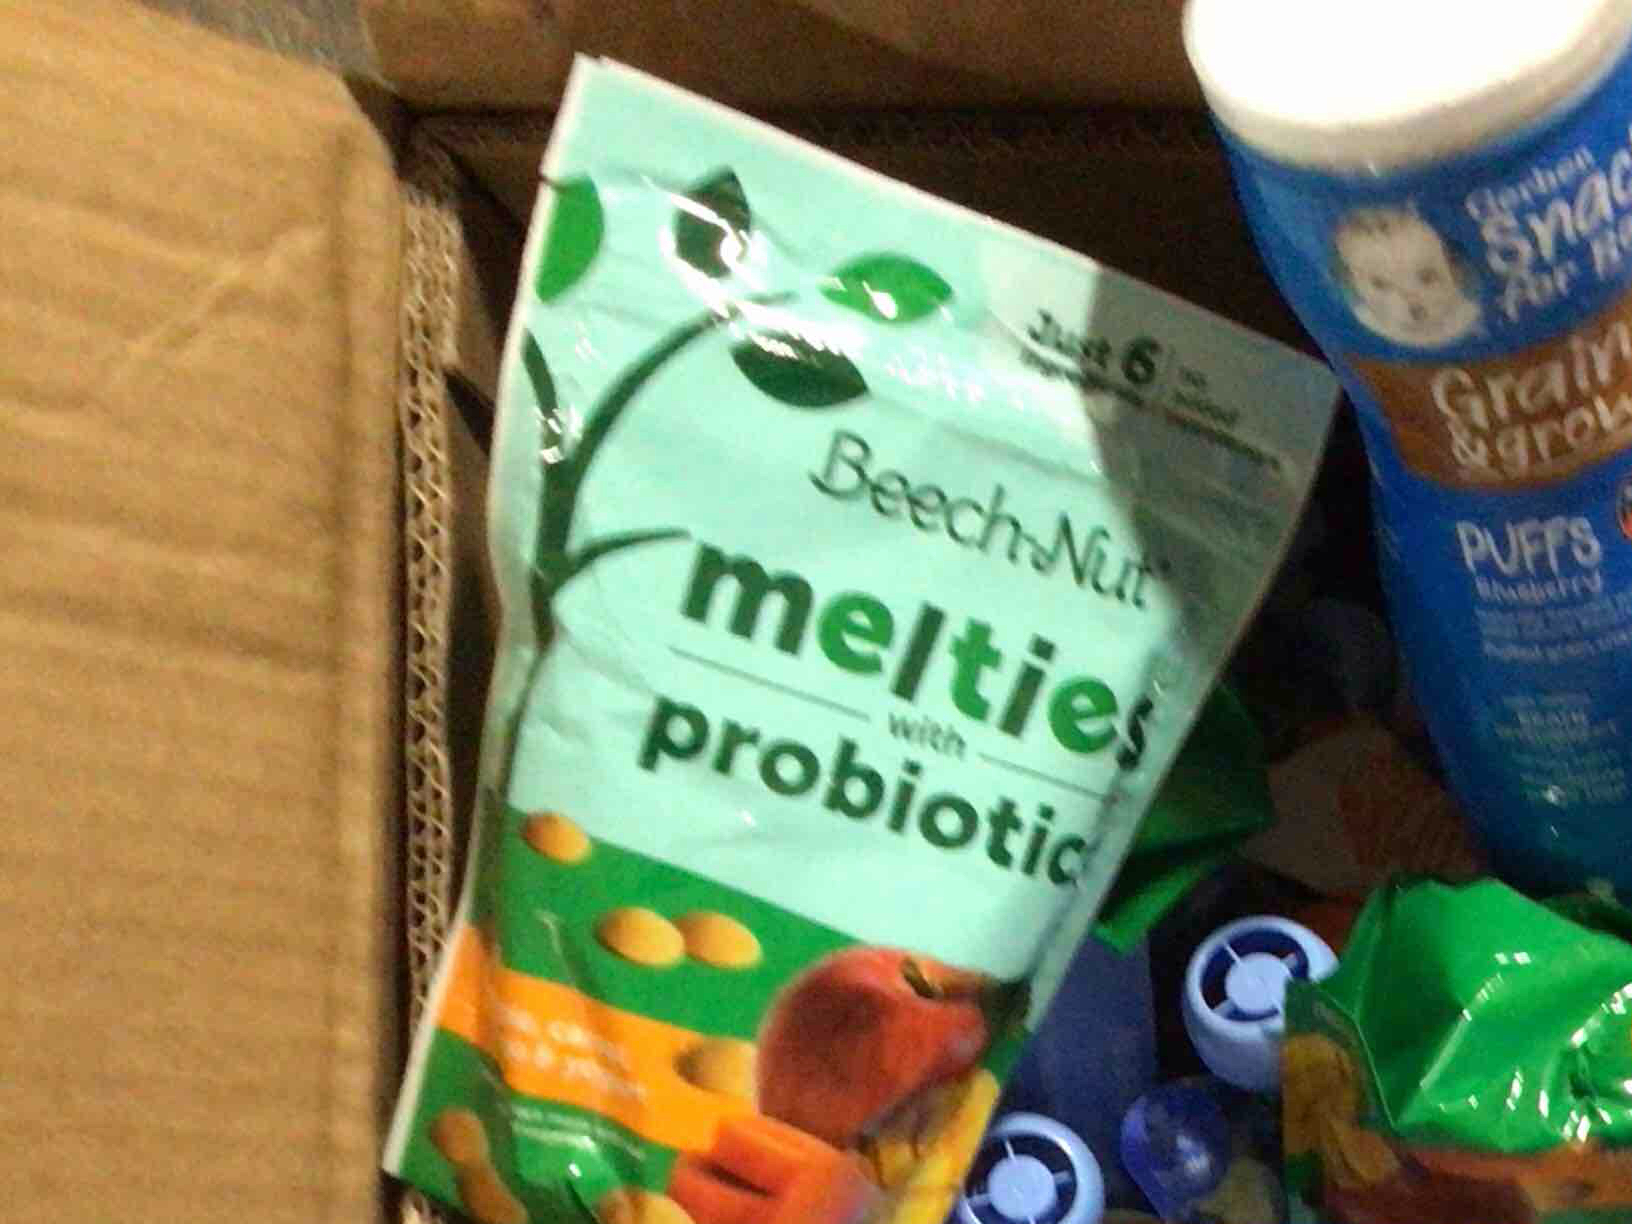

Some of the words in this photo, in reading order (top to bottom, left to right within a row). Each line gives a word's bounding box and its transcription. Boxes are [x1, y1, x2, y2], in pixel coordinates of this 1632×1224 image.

[1121, 335, 1161, 386] 6
[1431, 320, 1632, 432] Grain
[810, 430, 1152, 609] Beech-Nut
[1456, 516, 1603, 577] PUFFS
[888, 710, 968, 760] with
